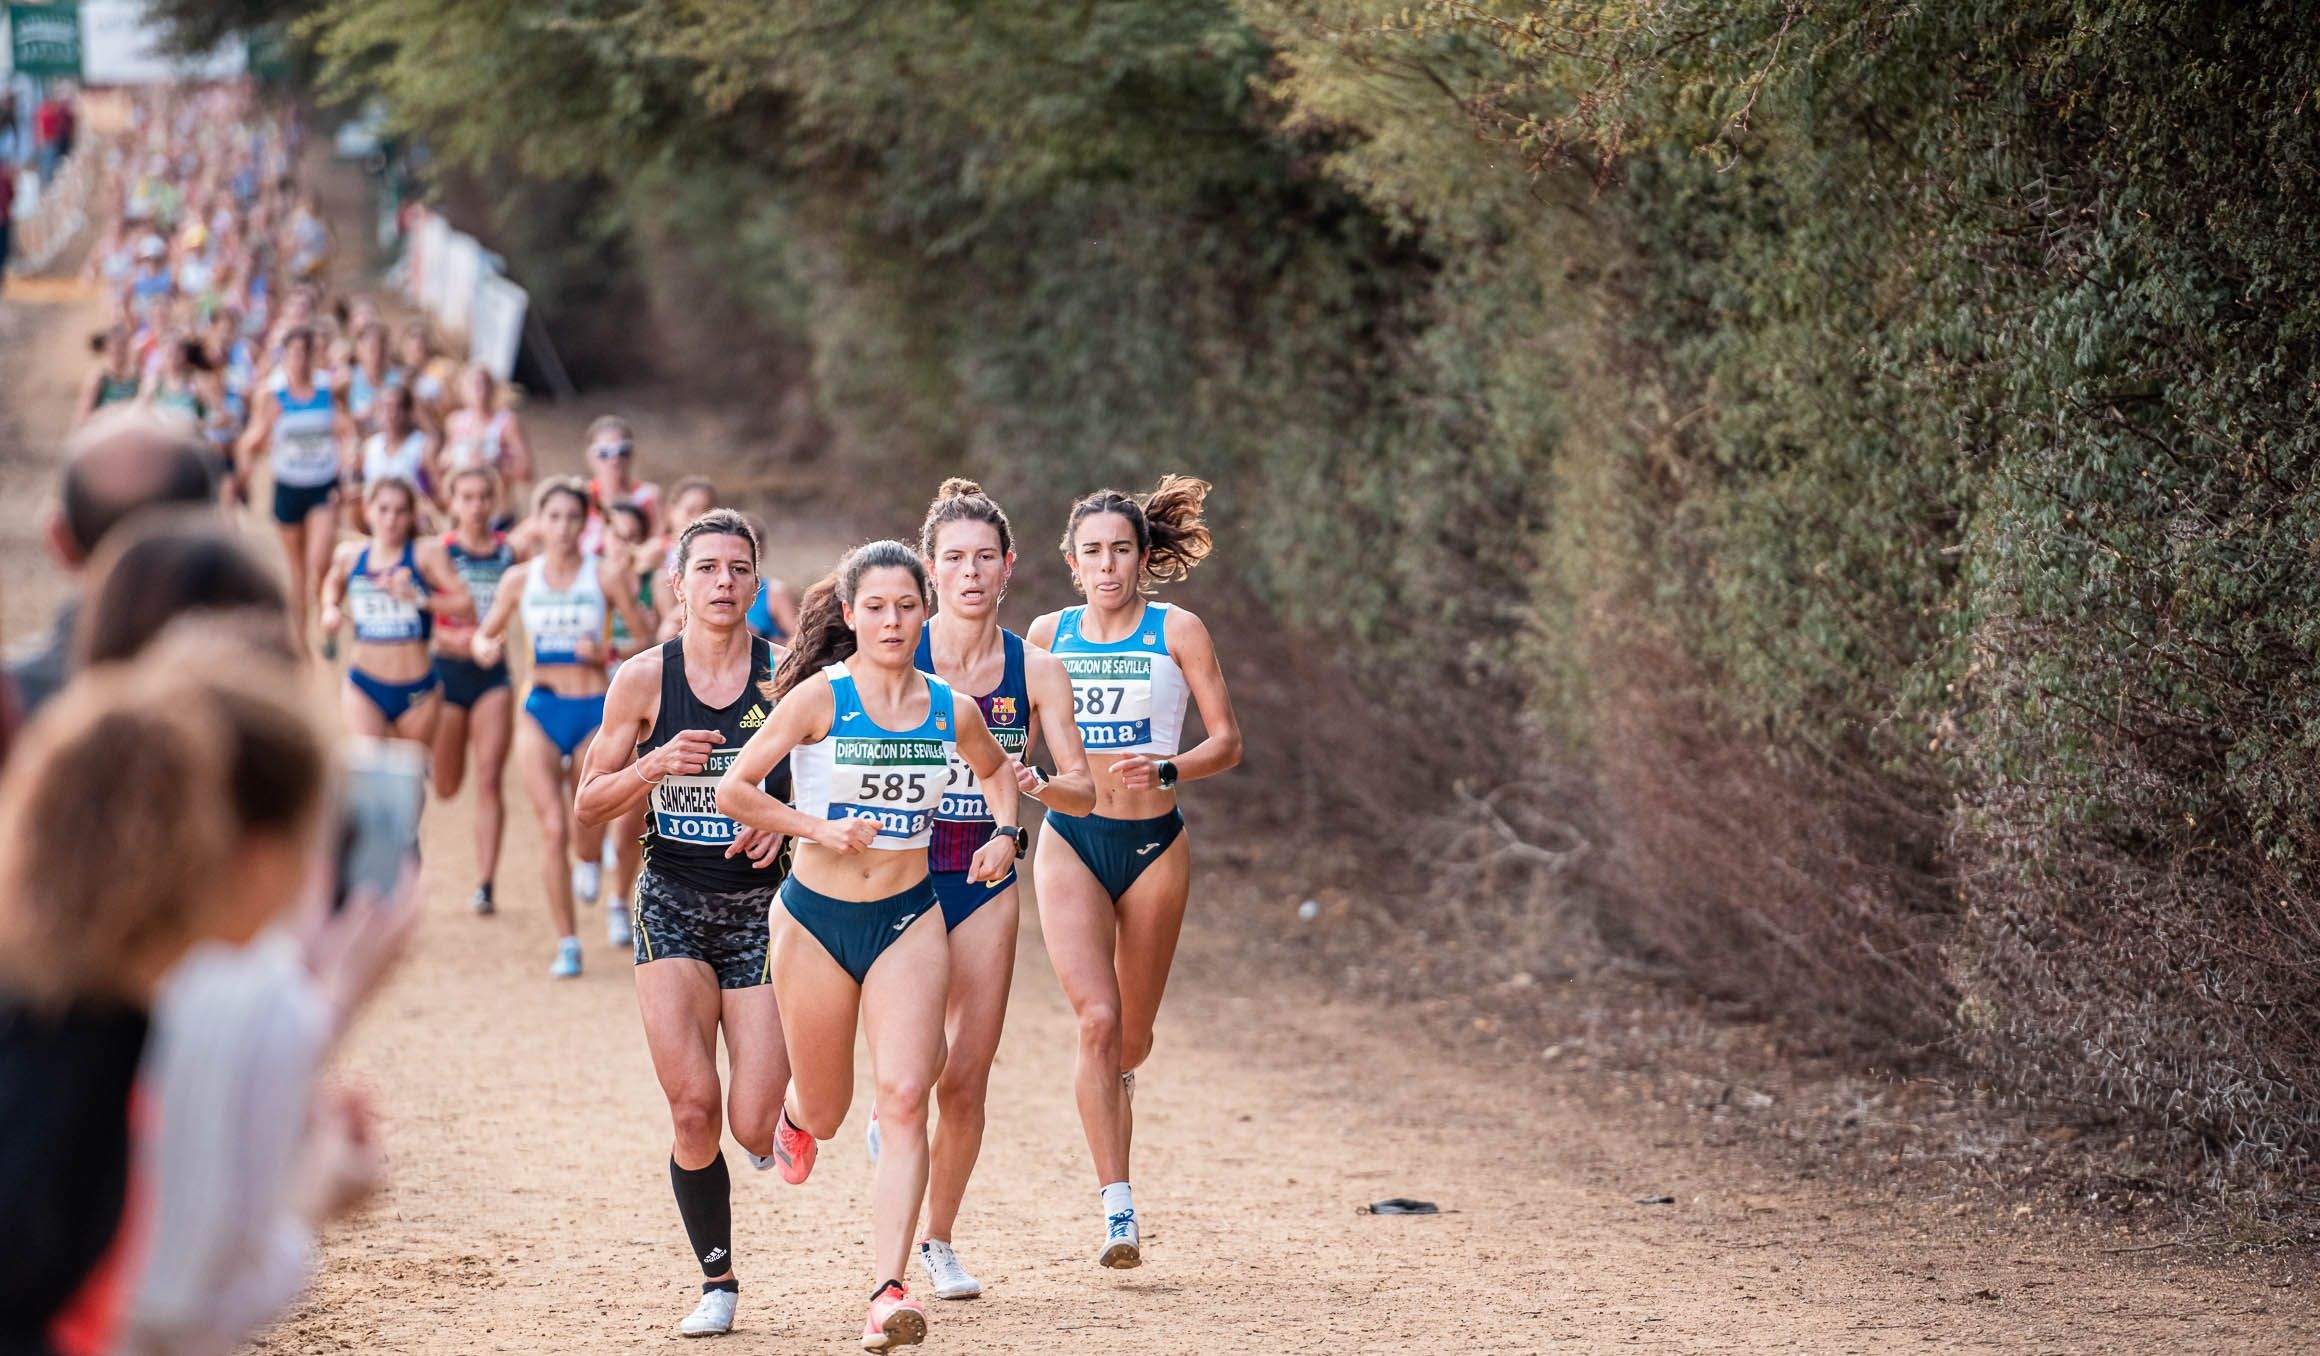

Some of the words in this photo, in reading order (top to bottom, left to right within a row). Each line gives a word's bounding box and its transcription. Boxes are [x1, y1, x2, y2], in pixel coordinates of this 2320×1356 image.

[1102, 659, 1112, 674] DE
[1113, 660, 1150, 675] SEVILLA
[1073, 686, 1125, 715] 587
[739, 718, 766, 729] adida
[899, 743, 913, 759] DE
[914, 743, 946, 758] SEVILLA
[710, 757, 724, 771] DE
[946, 759, 975, 787] 51
[660, 778, 718, 814] SÁNCHEZ-ES
[859, 774, 925, 803] 585
